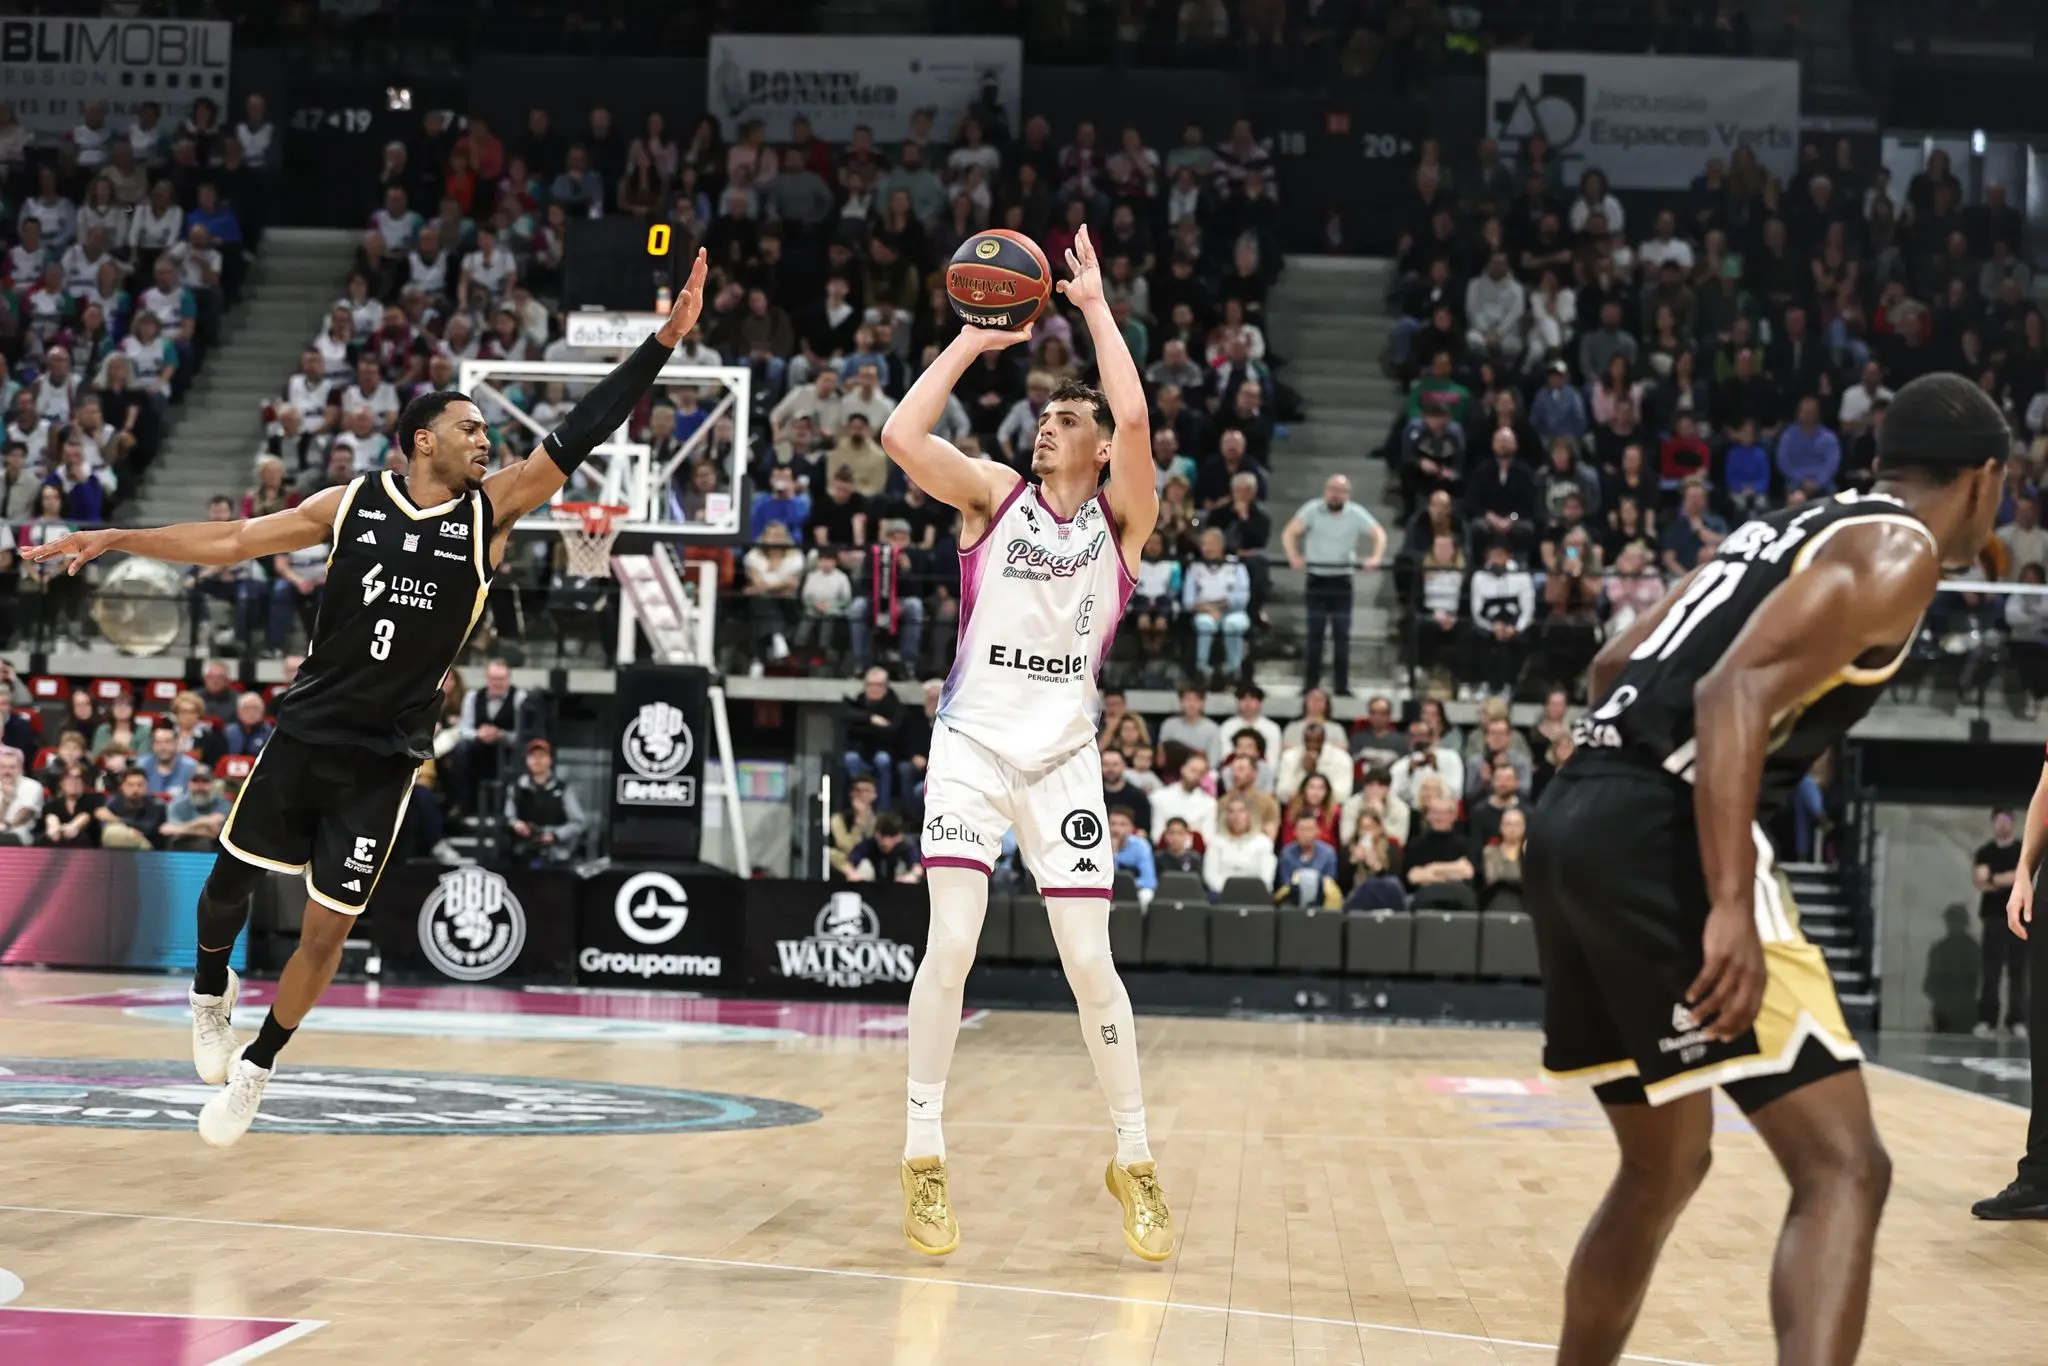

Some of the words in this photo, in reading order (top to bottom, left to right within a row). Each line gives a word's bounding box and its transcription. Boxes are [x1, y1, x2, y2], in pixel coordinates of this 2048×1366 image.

[344, 107, 372, 134] 19
[1589, 118, 1709, 150] Espaces
[1361, 132, 1397, 158] 20
[647, 224, 671, 255] 0
[951, 271, 1016, 296] SPALDING
[960, 310, 1008, 326] Betclic
[357, 508, 387, 521] swile
[440, 520, 469, 536] DCB
[391, 575, 438, 597] LDLC
[388, 593, 434, 610] ASVEL
[1075, 594, 1095, 636] 8
[370, 618, 396, 661] 3
[443, 867, 504, 918] BBD
[579, 947, 721, 979] Groupama
[775, 940, 916, 982] WATSONS
